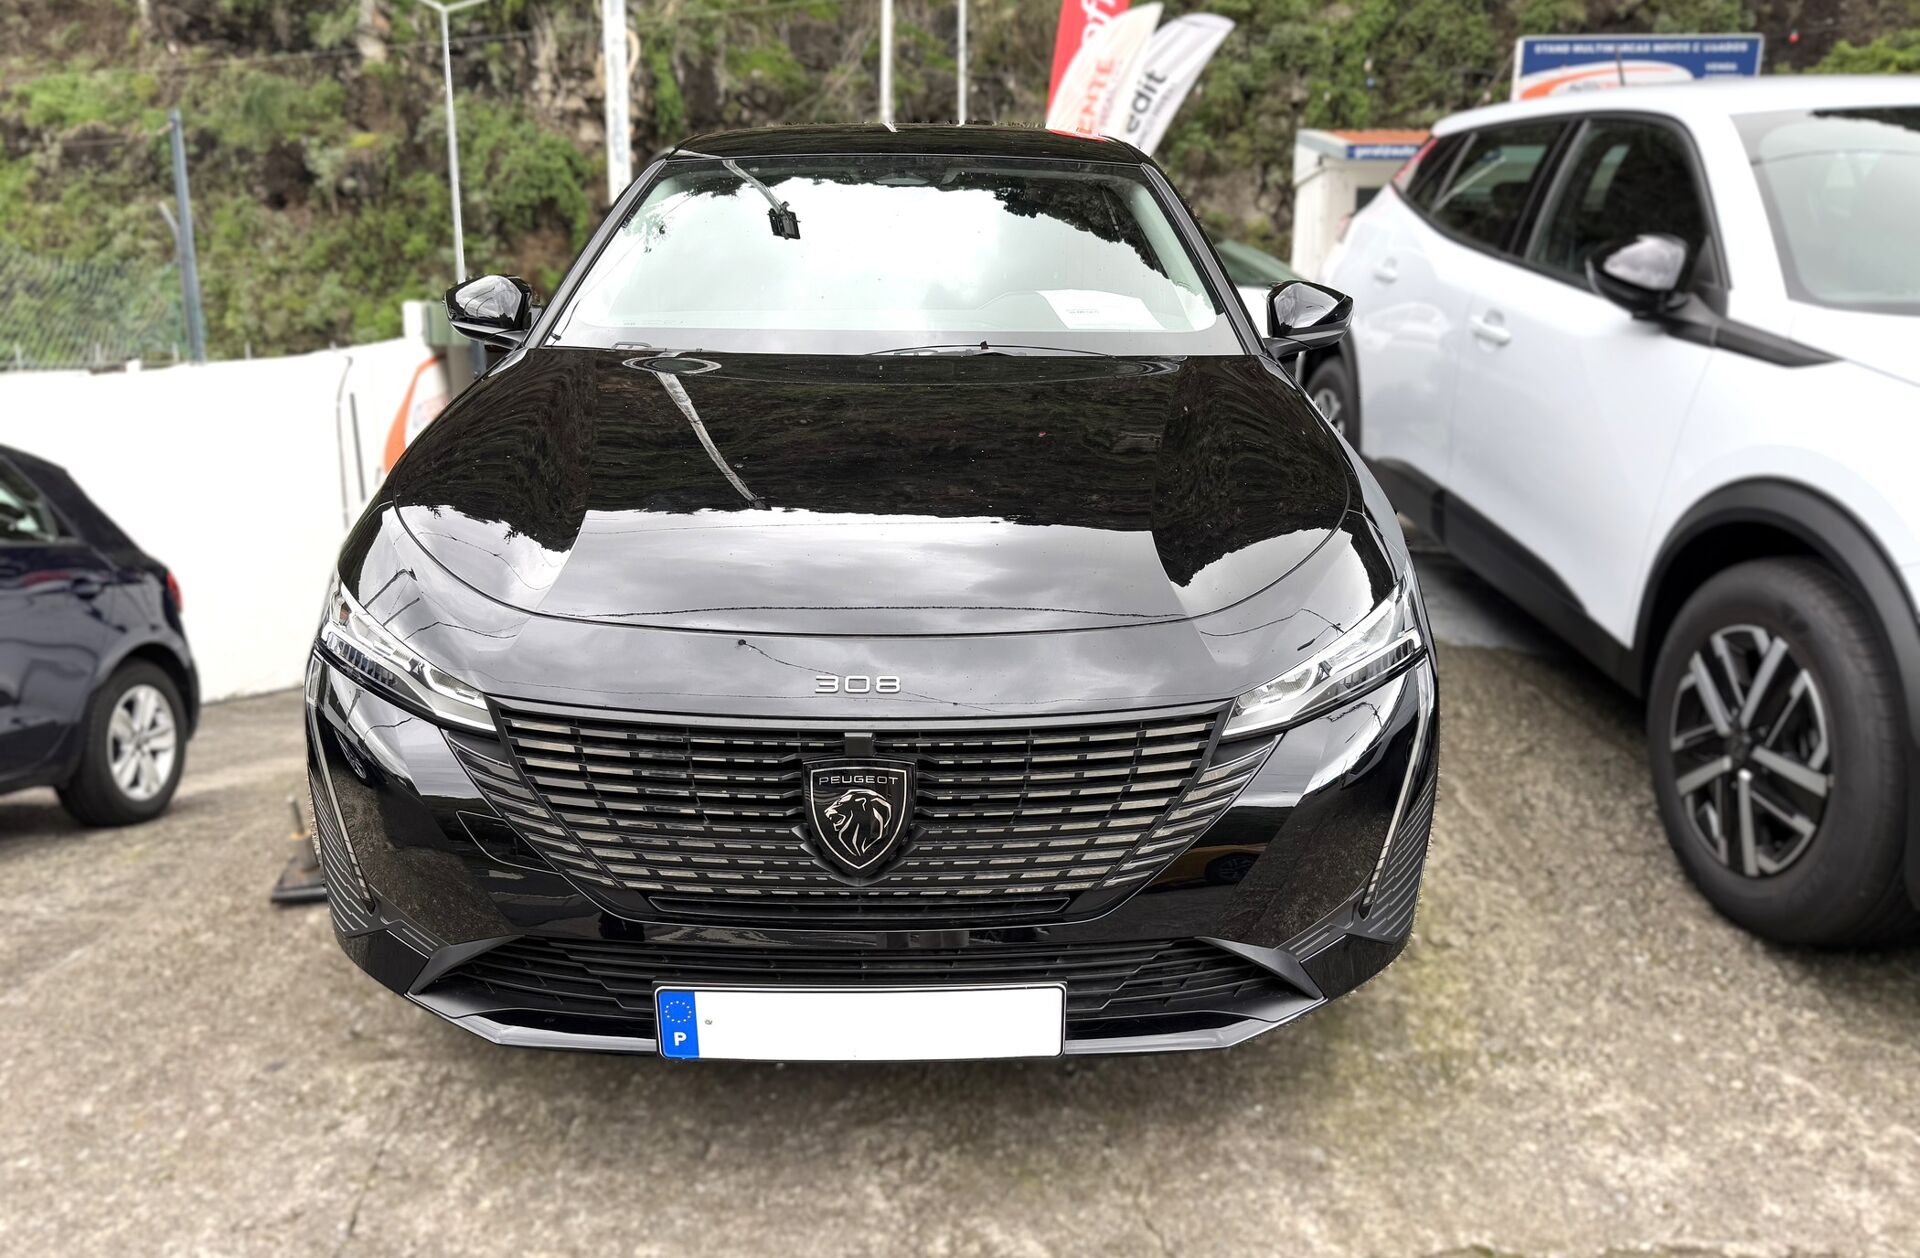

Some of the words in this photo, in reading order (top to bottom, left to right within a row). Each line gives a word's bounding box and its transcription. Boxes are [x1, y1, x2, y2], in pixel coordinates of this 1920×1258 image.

[815, 675, 901, 694] 308
[818, 775, 899, 786] PEUGEOT
[673, 1031, 687, 1047] P
